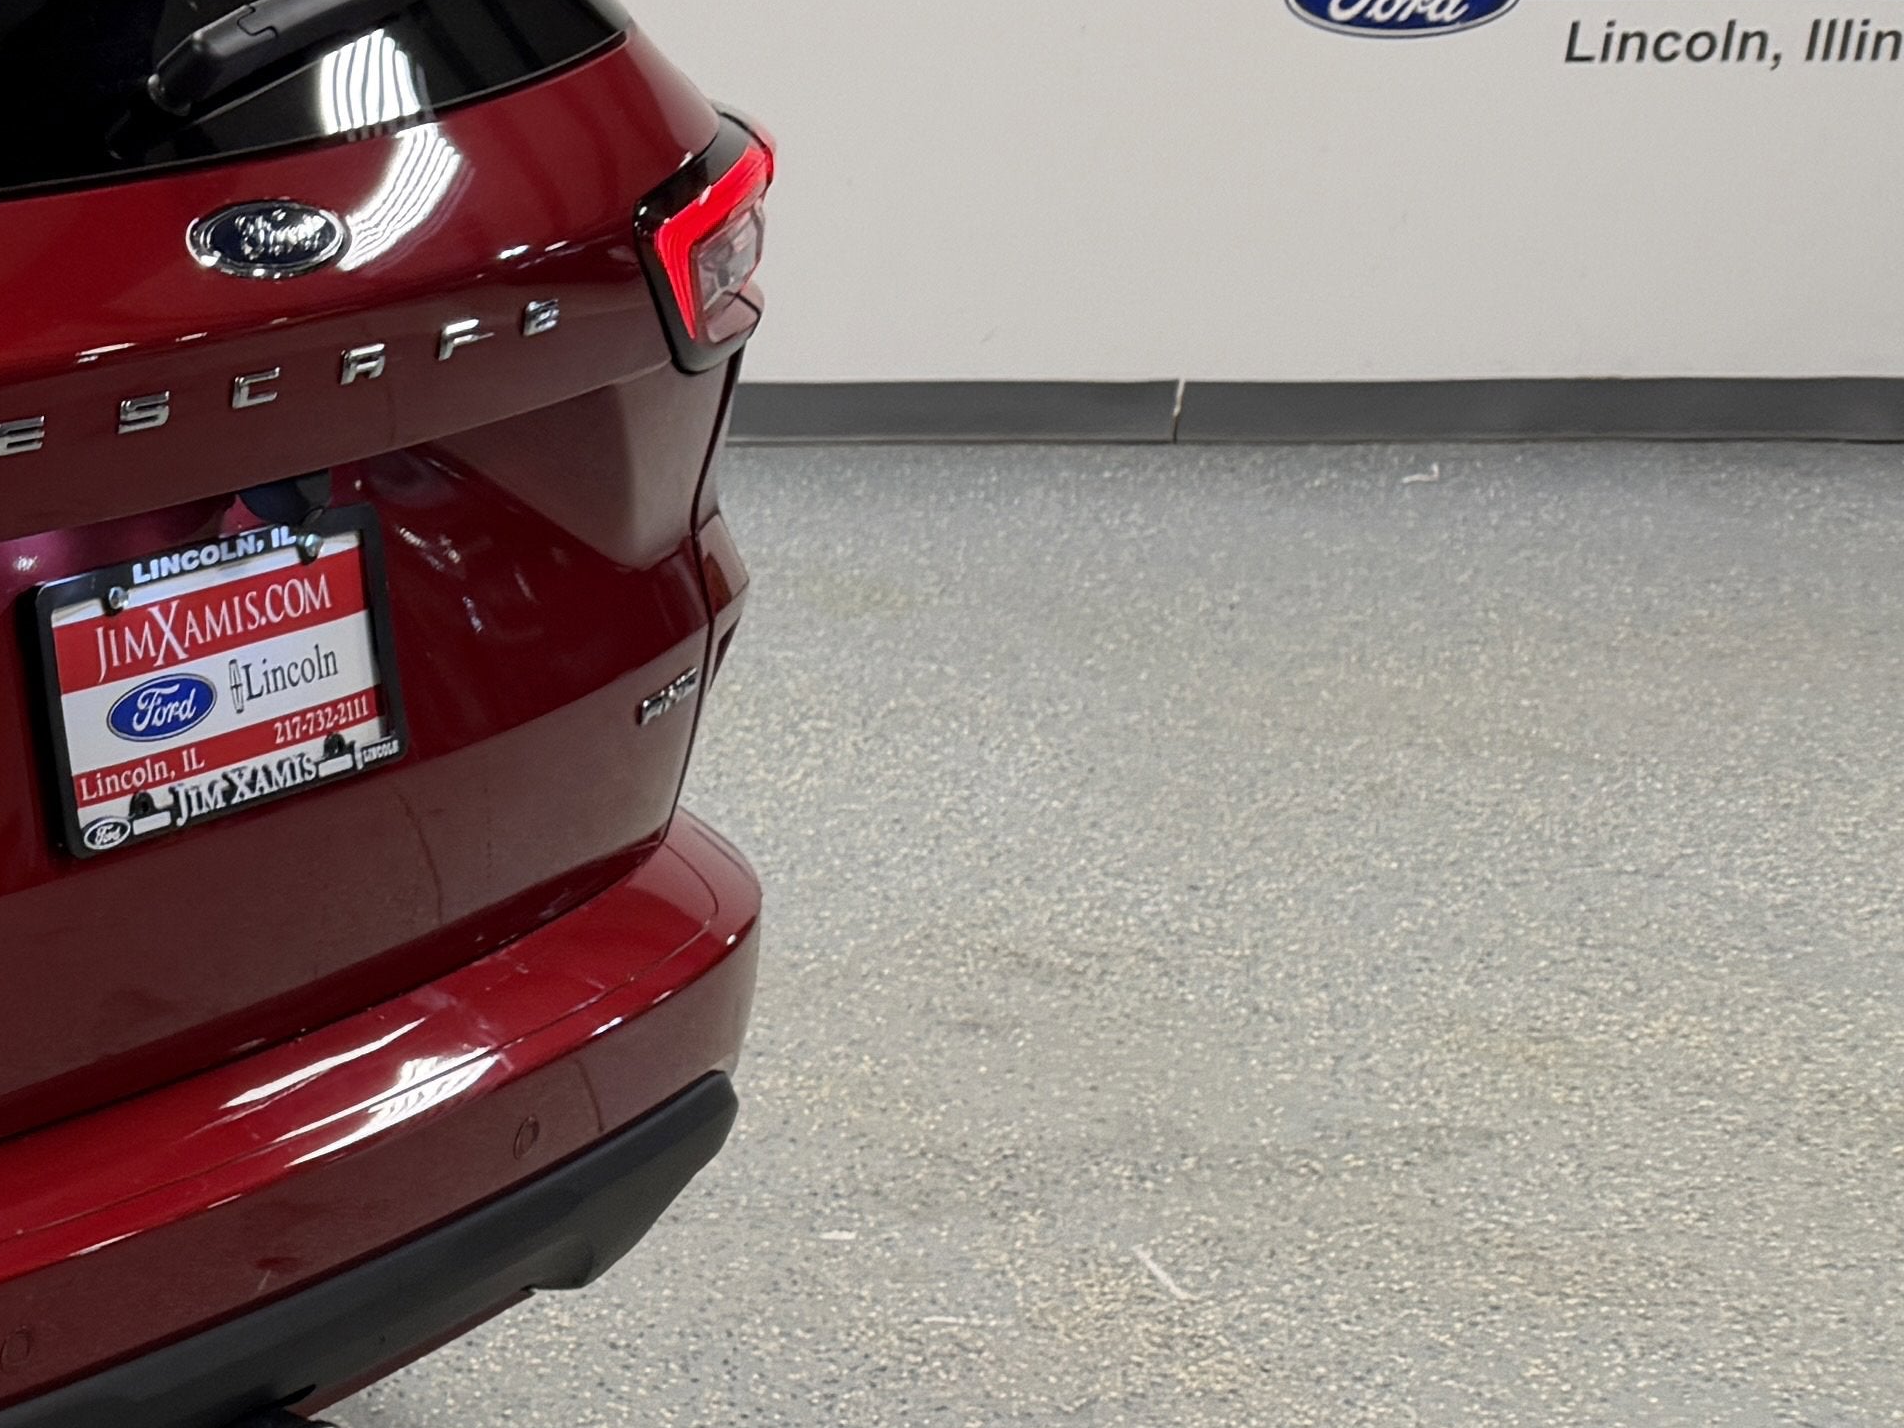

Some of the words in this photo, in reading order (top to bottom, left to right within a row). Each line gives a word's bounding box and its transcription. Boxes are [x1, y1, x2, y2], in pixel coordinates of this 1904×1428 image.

[1563, 19, 1784, 70] Lincoln,
[1805, 18, 1904, 63] Illin
[131, 534, 264, 585] LINCOLN,
[270, 525, 298, 549] IL
[94, 573, 333, 684] JIMXAMIS.COM
[132, 682, 196, 732] Ford
[241, 643, 339, 702] Lincoln
[273, 695, 370, 745] 217-732-2111
[79, 757, 177, 802] Lincoln,
[183, 748, 206, 773] IL
[174, 782, 227, 827] JIM
